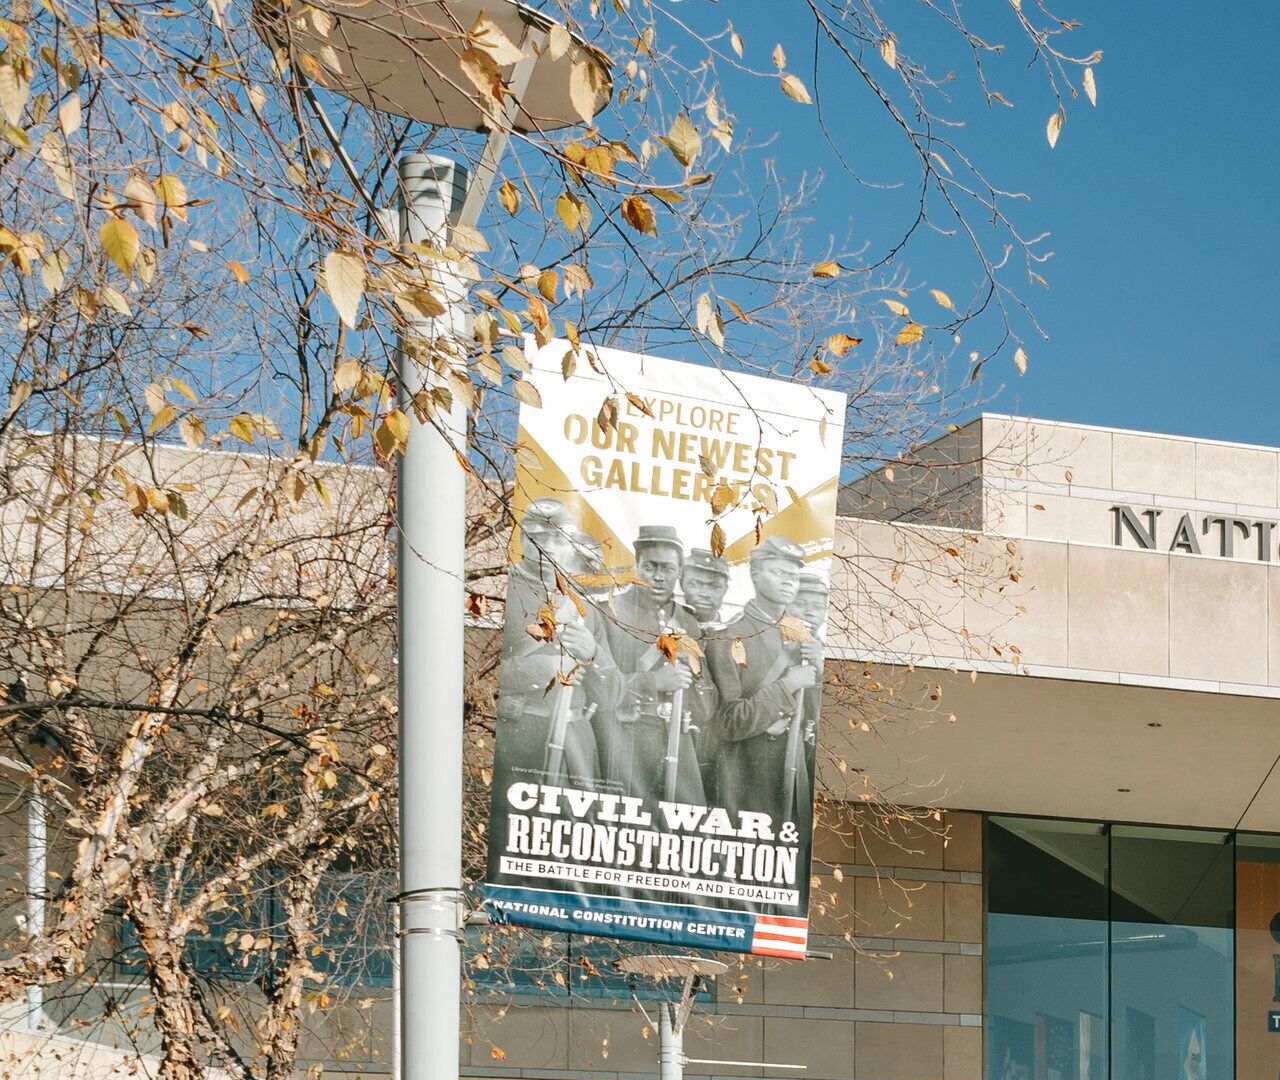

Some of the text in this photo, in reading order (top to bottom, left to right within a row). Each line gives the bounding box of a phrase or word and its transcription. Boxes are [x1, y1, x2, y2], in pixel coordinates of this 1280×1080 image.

[563, 413, 797, 480] OUR NEWEST
[507, 782, 800, 844] CIVIL WAR &
[506, 814, 800, 885] RECONSTRUCTION
[506, 859, 795, 902] THE BATTLE FOR FREEDOM AND EQUALITY
[493, 899, 746, 940] NATIONAL CONSTITUTION CENTER
